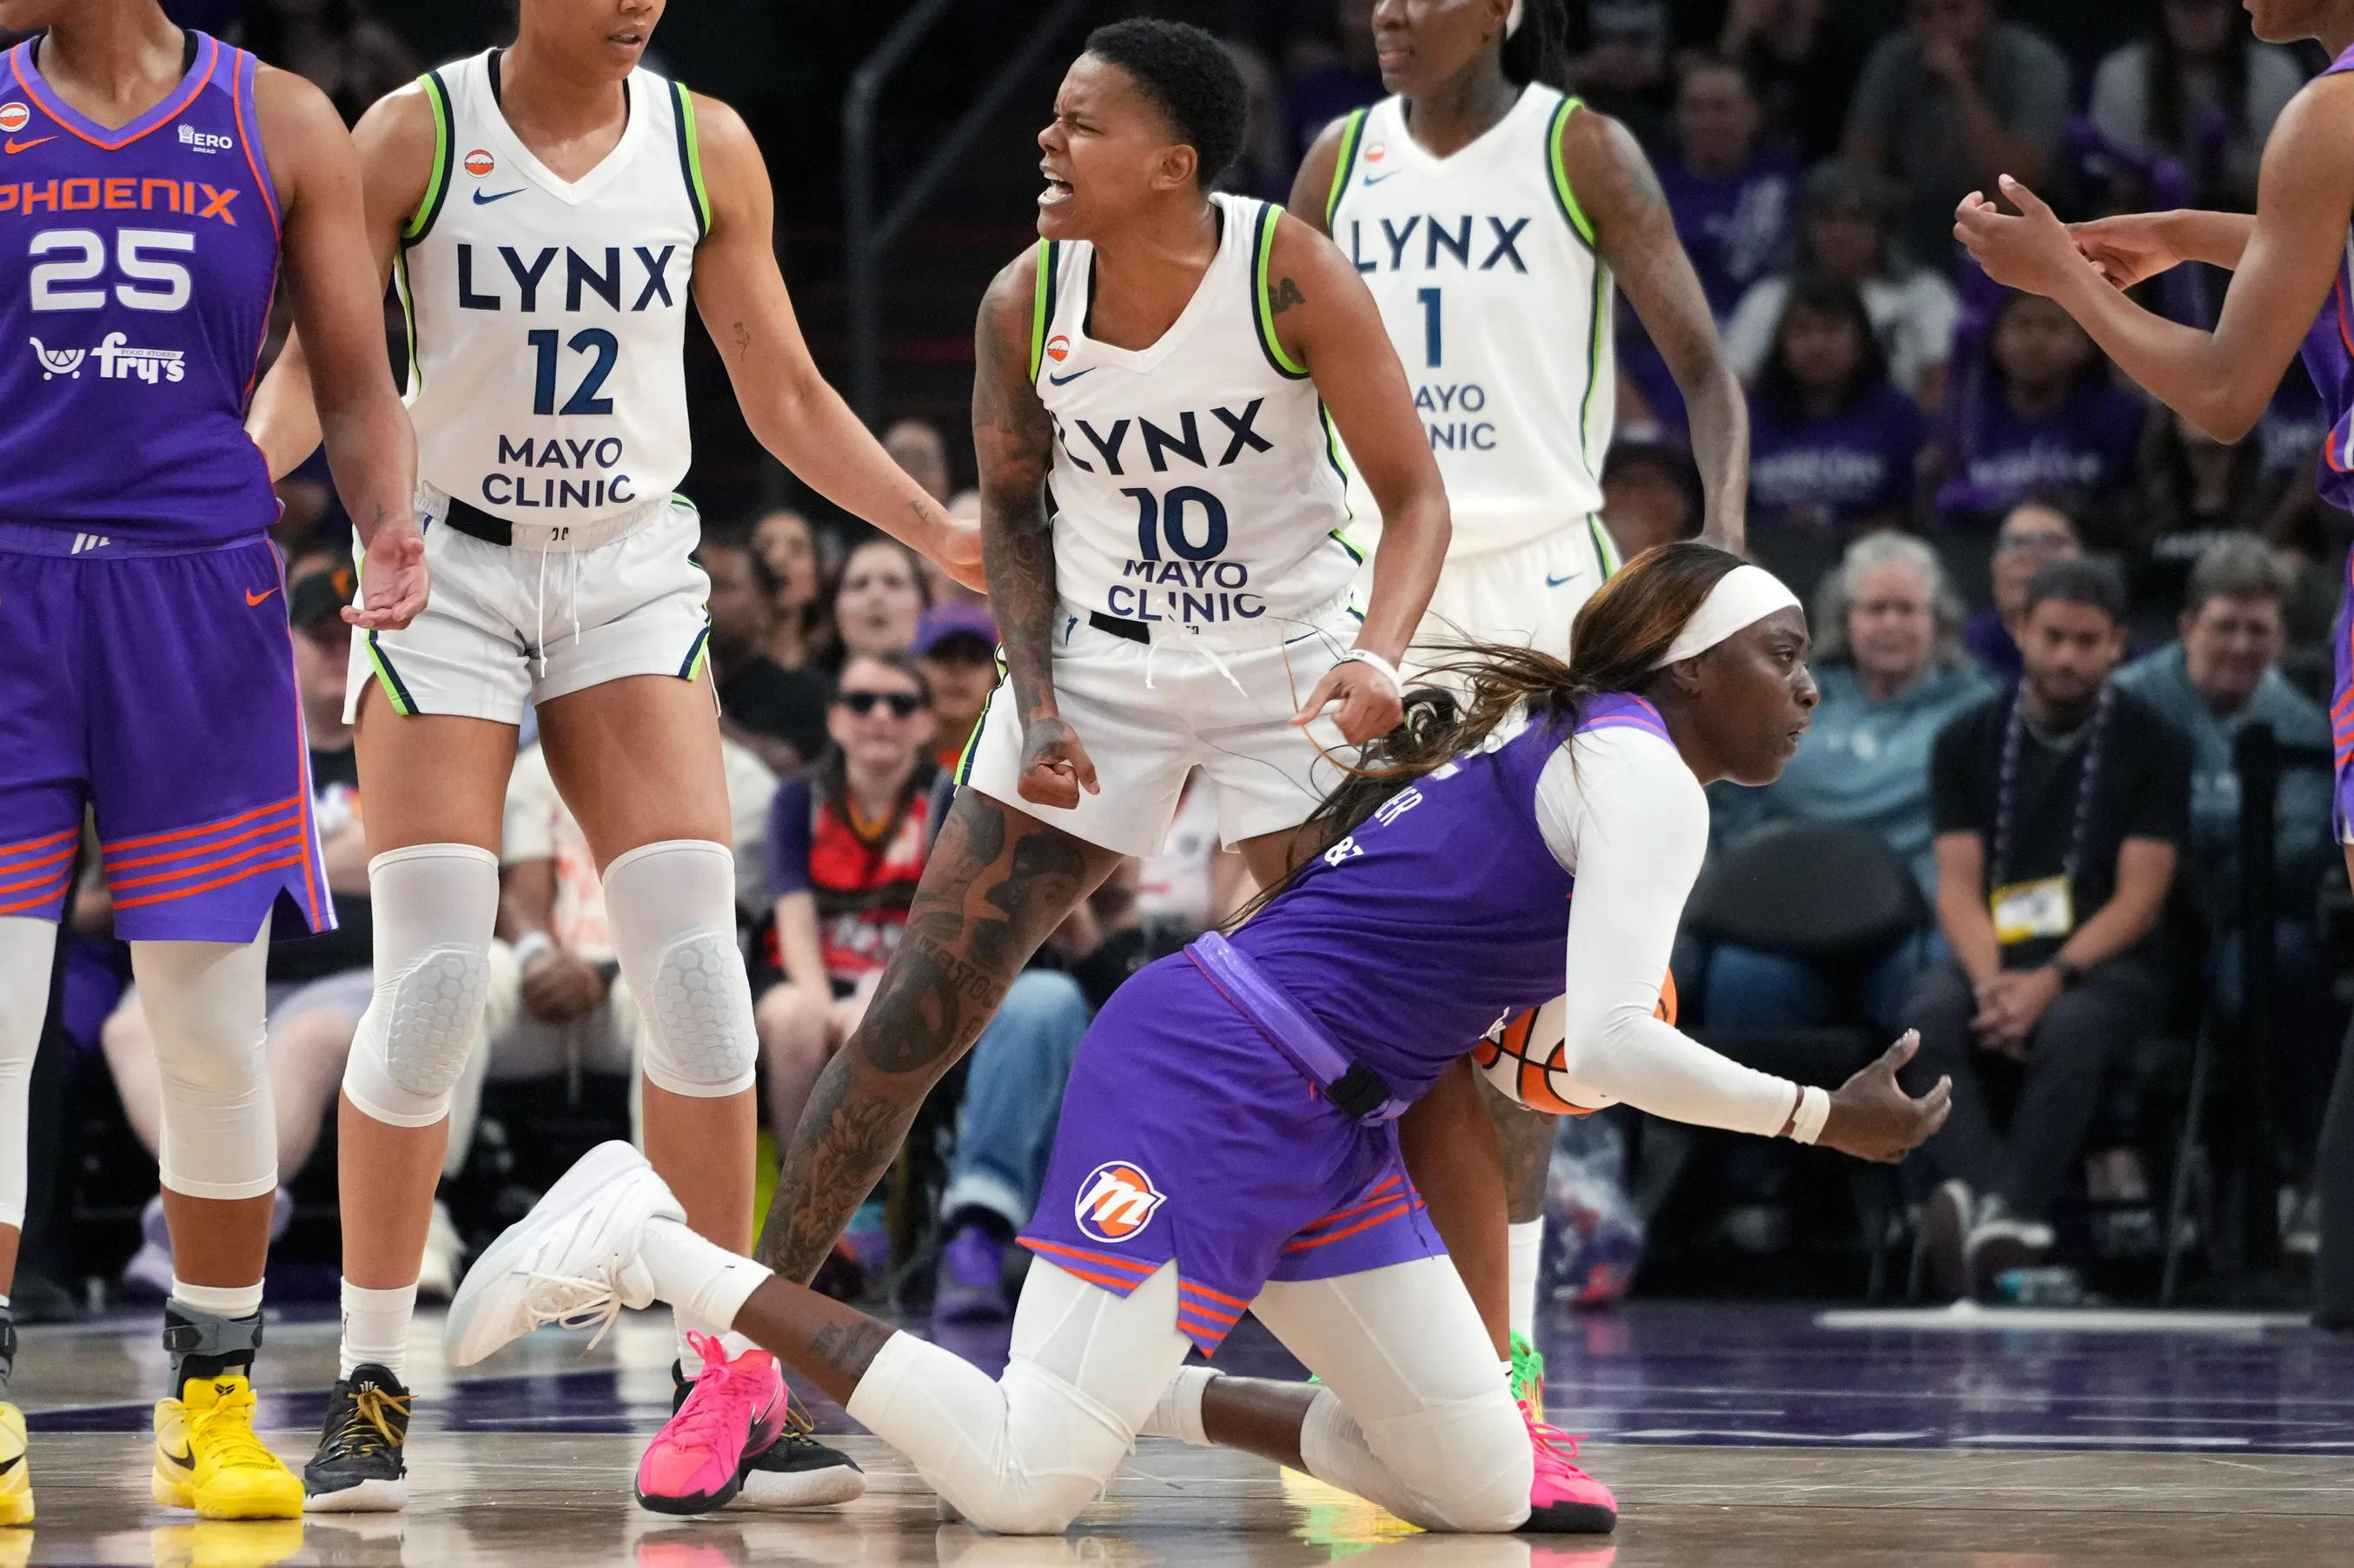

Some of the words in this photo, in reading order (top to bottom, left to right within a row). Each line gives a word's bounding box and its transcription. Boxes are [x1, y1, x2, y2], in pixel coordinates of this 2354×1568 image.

[177, 123, 233, 149] HERO
[0, 177, 241, 227] PHOENIX
[1350, 215, 1532, 275] LYNX
[29, 228, 196, 312] 25
[457, 243, 676, 313] LYNX
[1416, 288, 1442, 368] 1
[90, 331, 186, 384] fry's
[527, 327, 619, 416] 12
[1414, 384, 1485, 413] AYO
[498, 434, 623, 469] MAYO
[1429, 422, 1496, 451] NIC
[482, 473, 636, 508] CLINIC
[1119, 486, 1229, 562] 10
[1123, 559, 1248, 589] MAYO
[1108, 585, 1266, 623] CLINIC
[1324, 836, 1364, 867] &
